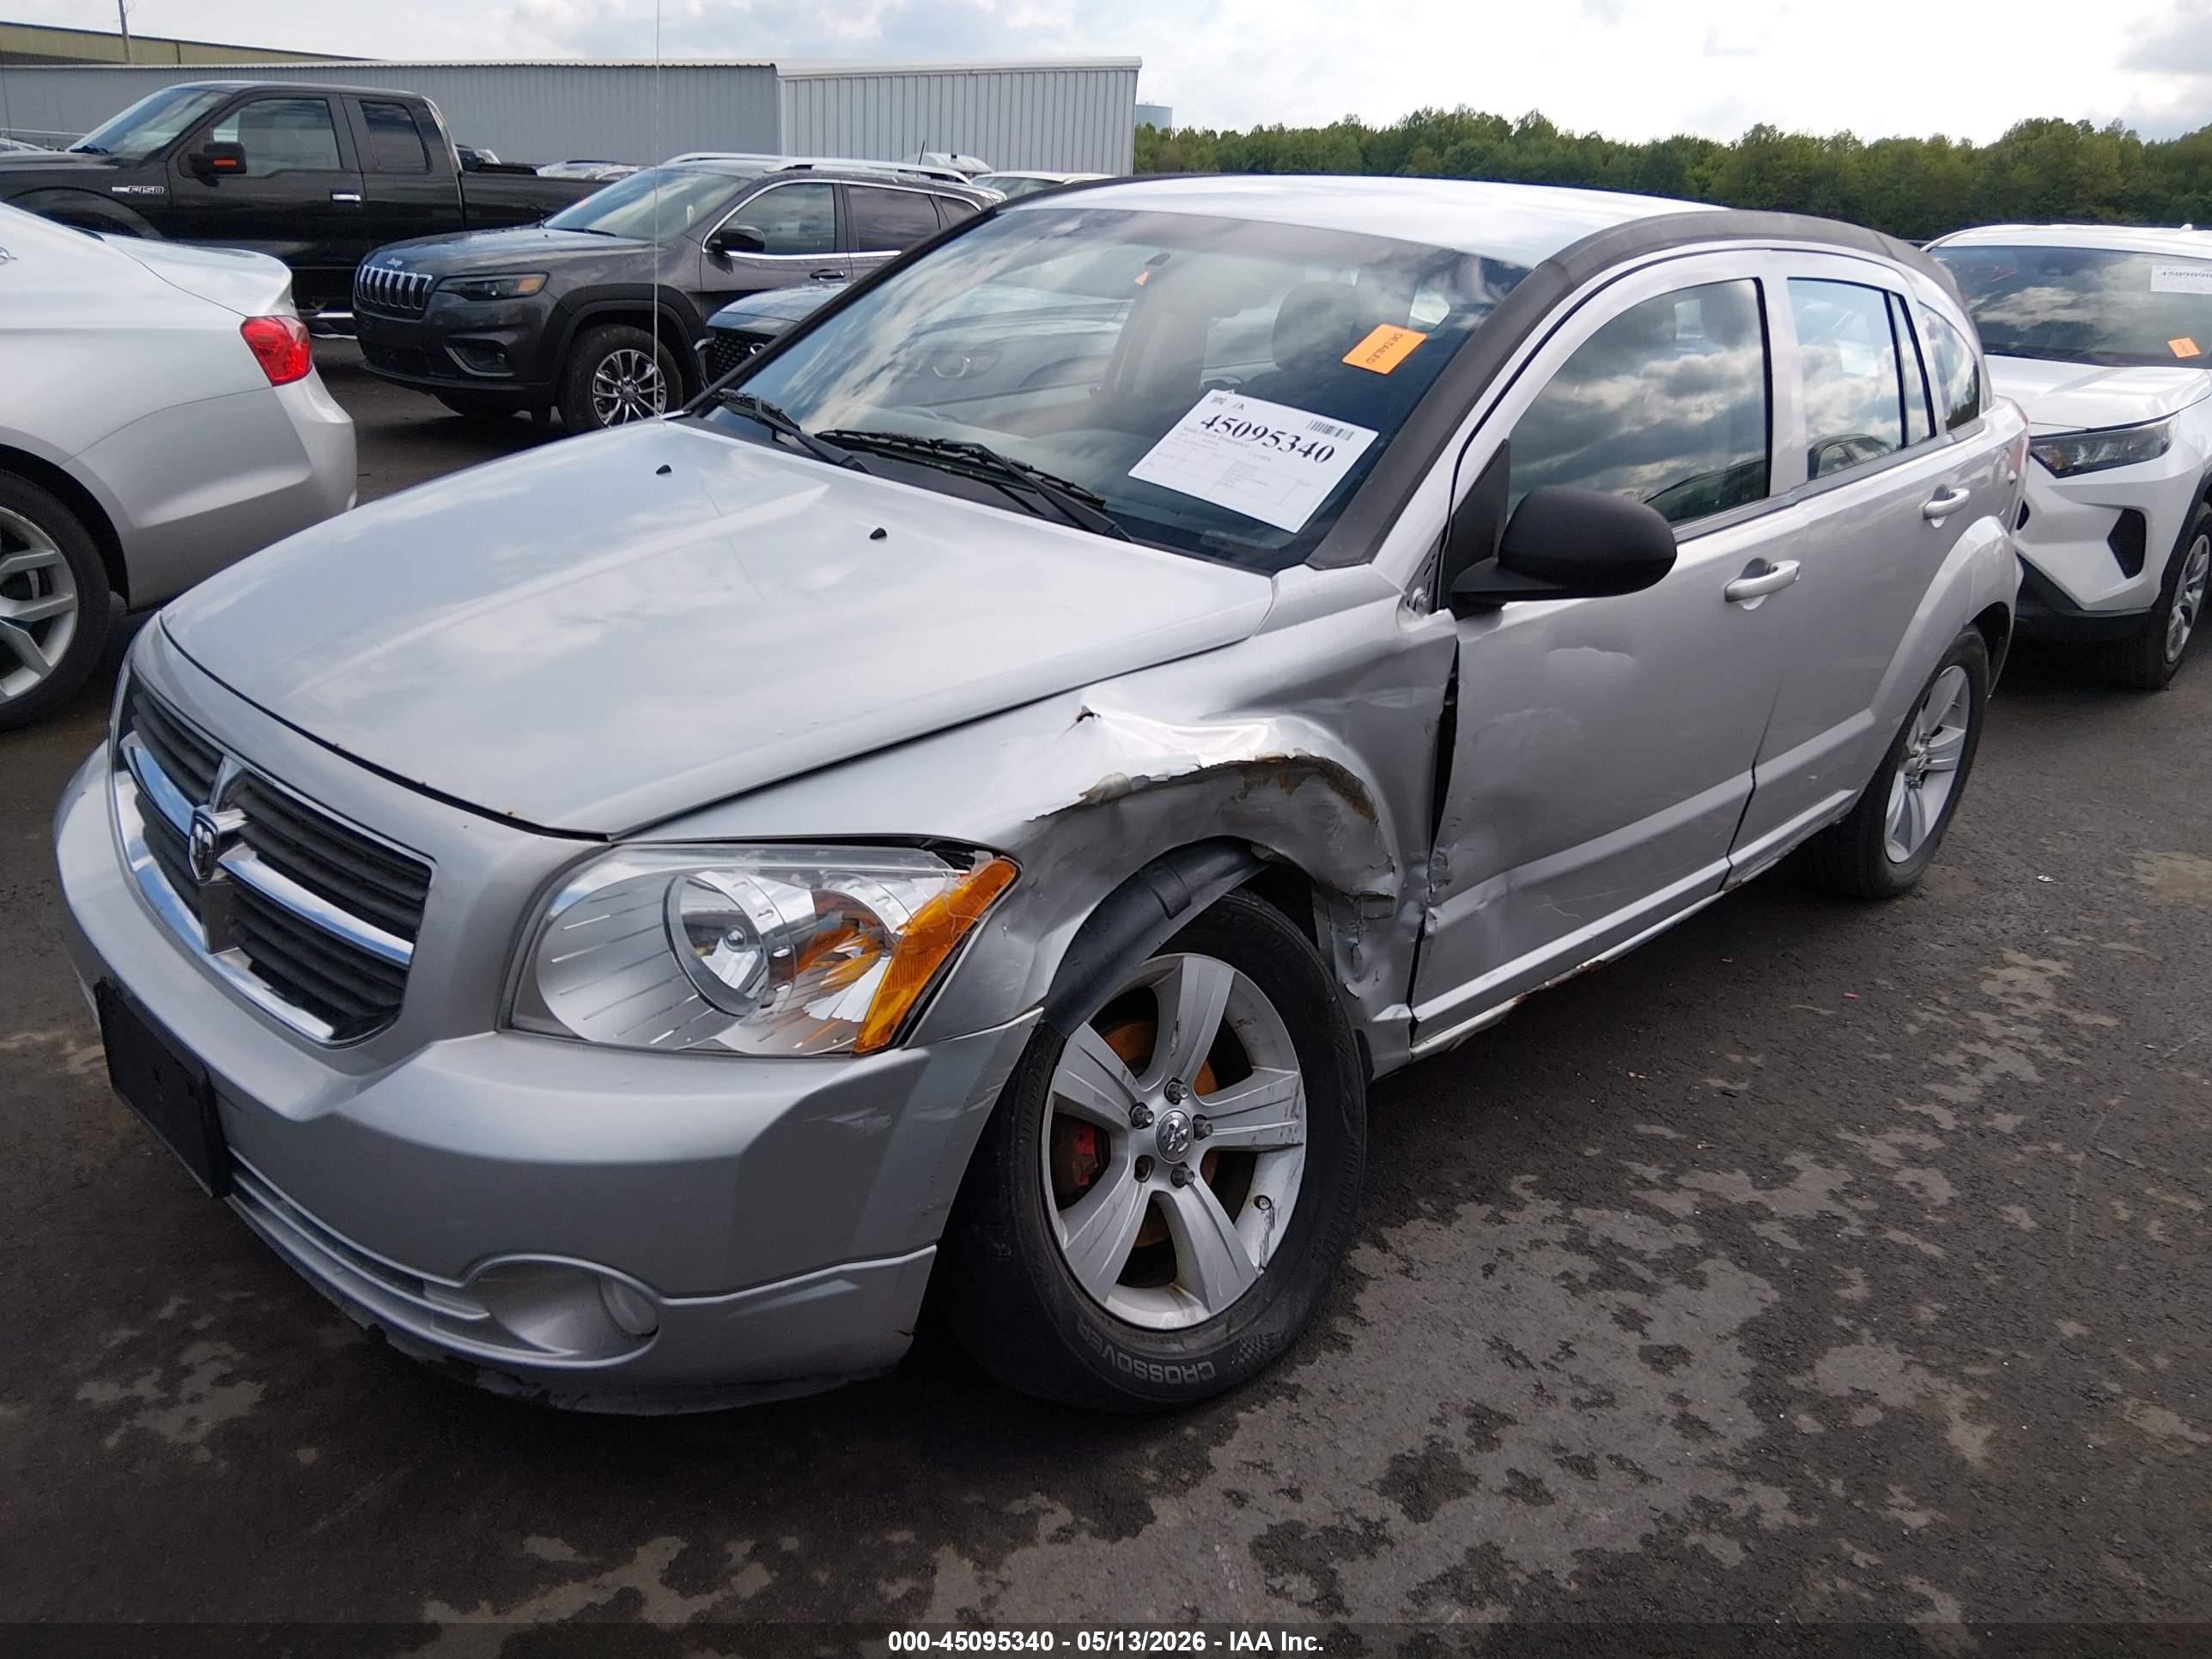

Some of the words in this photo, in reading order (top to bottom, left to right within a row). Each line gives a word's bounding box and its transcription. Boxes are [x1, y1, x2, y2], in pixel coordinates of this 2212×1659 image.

[1366, 332, 1403, 364] DETAILED
[1200, 414, 1335, 464] 45095340
[1076, 1317, 1217, 1384] CROSSOVER
